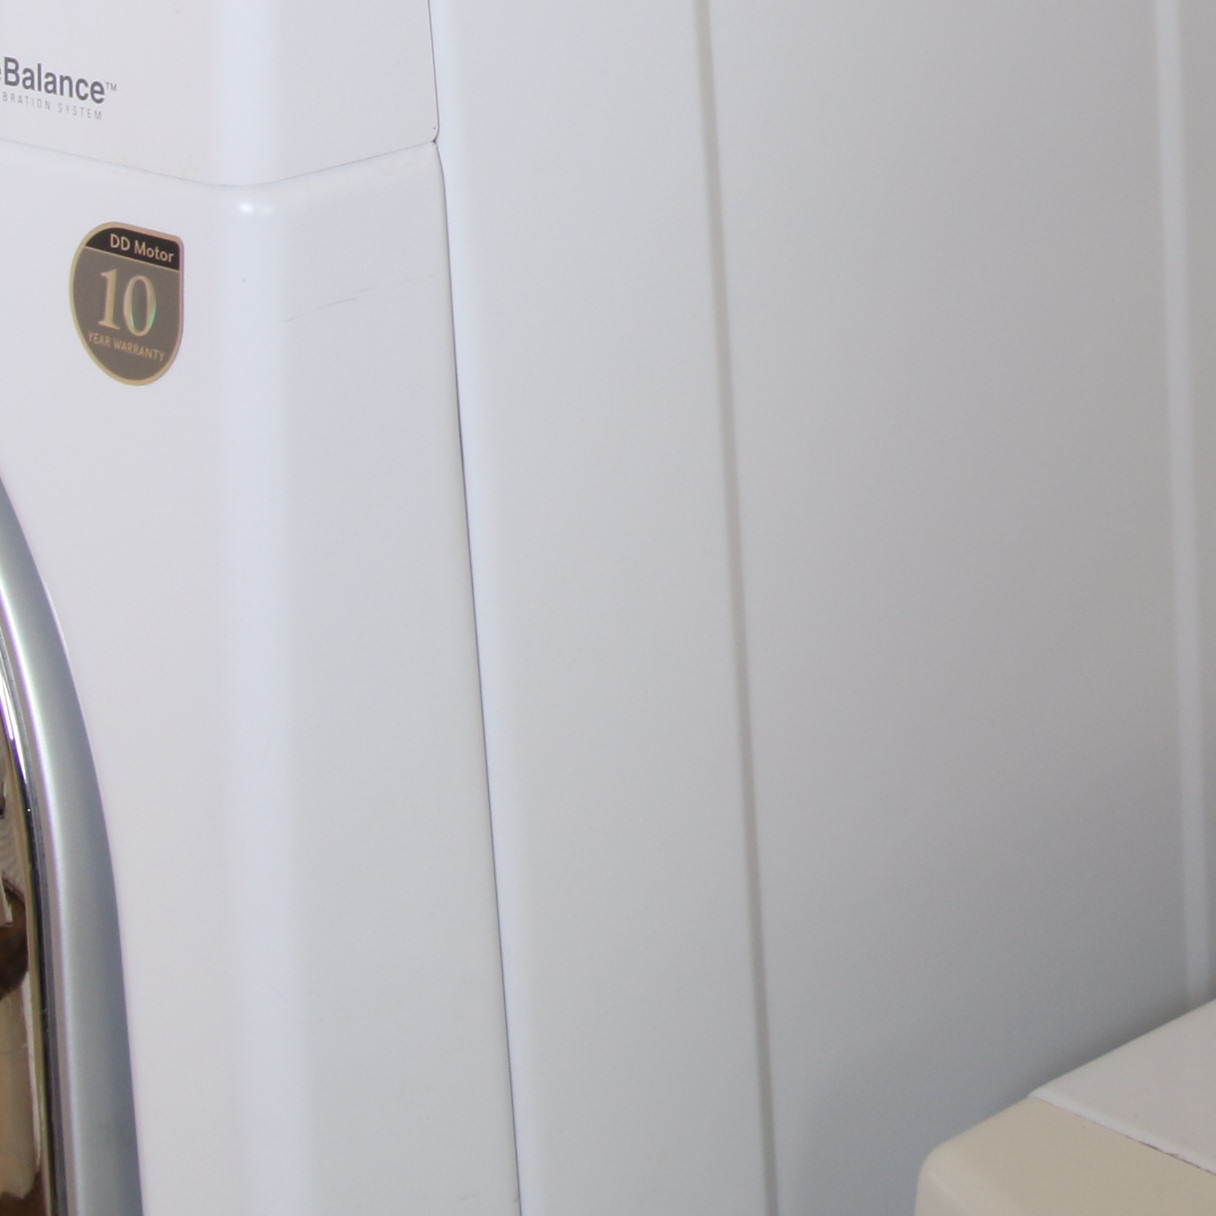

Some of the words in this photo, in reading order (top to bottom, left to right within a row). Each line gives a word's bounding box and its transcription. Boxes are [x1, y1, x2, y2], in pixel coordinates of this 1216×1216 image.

[58, 102, 102, 121] SYSTEM
[110, 233, 130, 251] DD
[134, 239, 174, 263] Motor
[98, 268, 156, 337] 10
[88, 332, 110, 348] YEAR
[113, 337, 165, 363] WARRANTY
